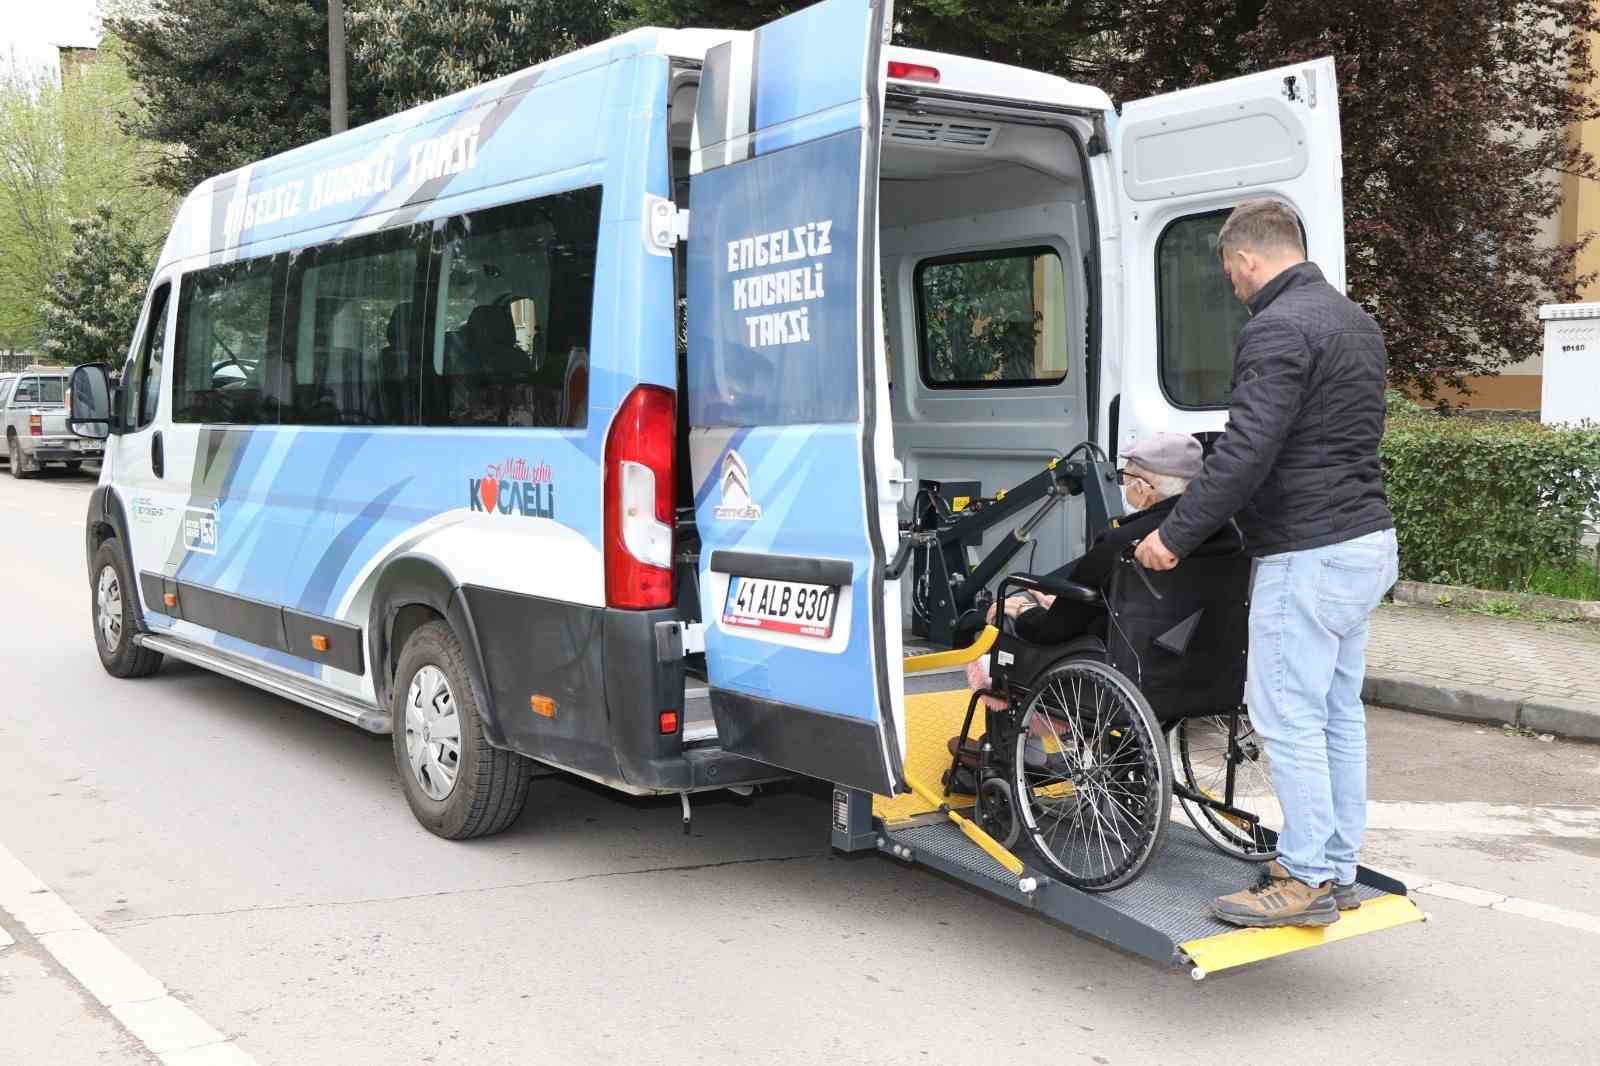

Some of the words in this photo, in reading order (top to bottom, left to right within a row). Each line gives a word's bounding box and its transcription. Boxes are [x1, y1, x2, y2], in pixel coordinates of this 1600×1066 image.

[727, 220, 833, 272] ENGELSİZ
[732, 263, 825, 311] KOCAELİ
[745, 307, 810, 347] TAKSİ
[736, 581, 756, 613] 41
[757, 584, 792, 617] ALB
[795, 588, 830, 622] 930
